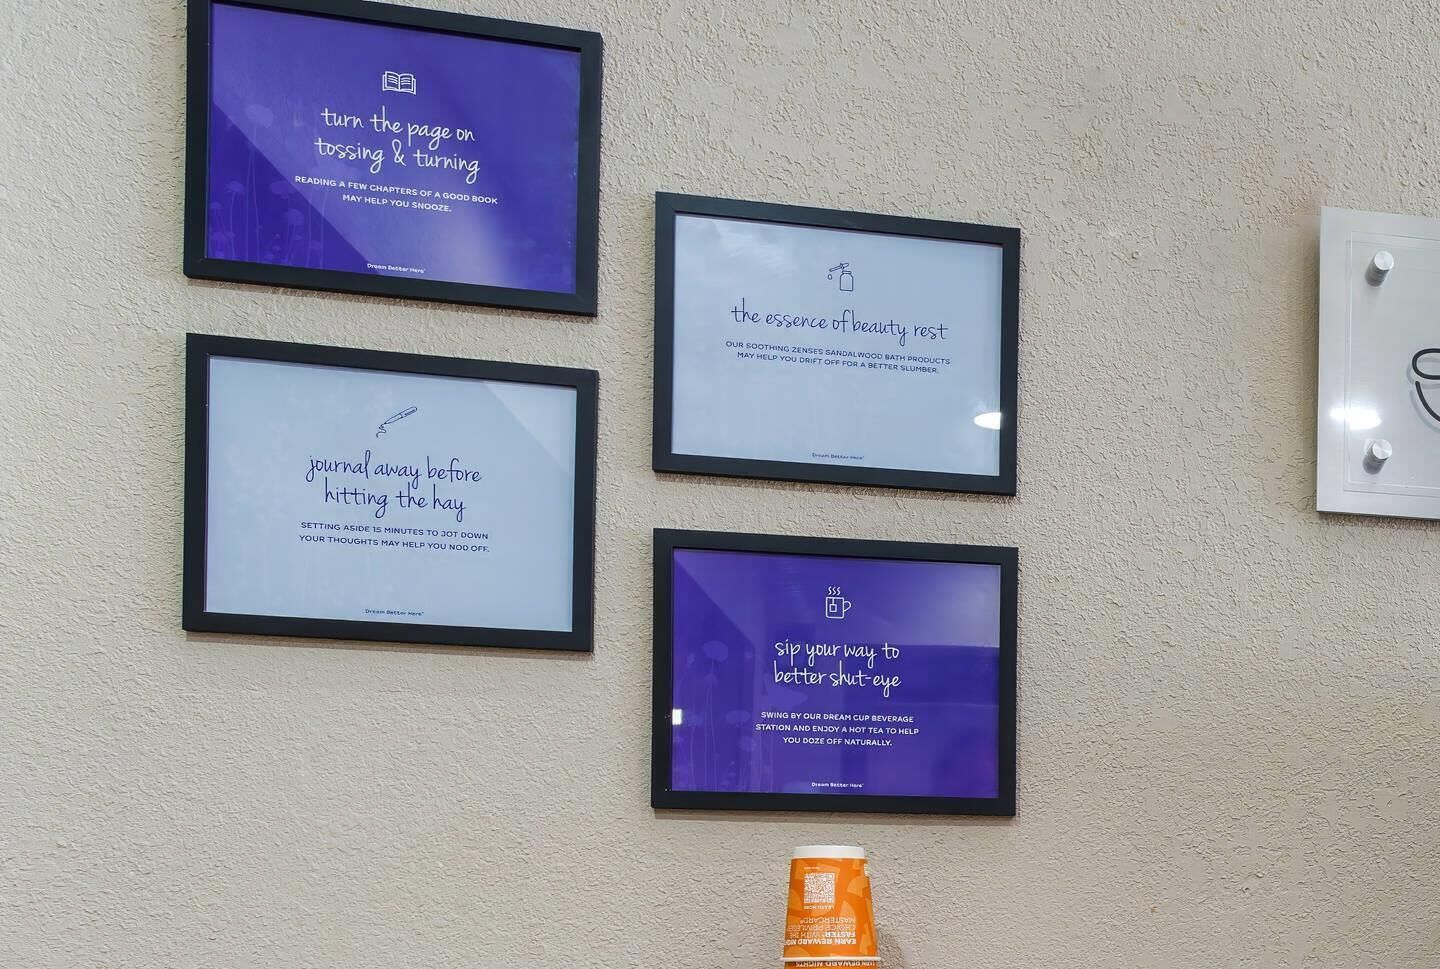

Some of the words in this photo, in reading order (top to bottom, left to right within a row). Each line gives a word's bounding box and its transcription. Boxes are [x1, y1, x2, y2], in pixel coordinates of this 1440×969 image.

[321, 108, 364, 128] turn
[370, 105, 403, 133] the
[408, 122, 452, 150] page
[456, 129, 475, 141] on
[315, 138, 384, 173] tossing
[392, 139, 406, 166] &
[413, 150, 480, 184] turning
[295, 176, 337, 187] READING
[348, 182, 367, 190] FEW
[370, 184, 417, 196] CHAPTERS
[443, 192, 469, 201] GOOD
[472, 195, 498, 204] BOOK
[343, 194, 362, 202] MAY
[364, 197, 387, 205] HELP
[390, 200, 409, 208] YOU
[412, 202, 451, 212] SNOOZE.
[731, 298, 760, 323] the
[766, 313, 828, 329] essence
[832, 310, 850, 333] of
[852, 310, 908, 346] beauty
[914, 323, 948, 339] rest
[746, 342, 789, 352] SOOTHING
[792, 346, 823, 355] ZENSES
[826, 349, 882, 359] SANDALWOOD
[908, 356, 950, 364] PRODUCTS
[757, 353, 777, 361] HELP
[800, 356, 822, 364] DRIFT
[868, 362, 898, 370] BETTER
[900, 365, 939, 373] SLUMBER.
[306, 450, 371, 482] journal
[374, 463, 422, 489] away
[427, 456, 482, 483] before
[325, 477, 388, 518] hitting
[396, 482, 428, 508] the
[433, 484, 466, 522] hay
[300, 535, 325, 543] YOUR
[328, 537, 378, 545] THOUGHTS
[301, 522, 340, 531] SETTING
[384, 527, 423, 535] MINUTES
[775, 639, 800, 666] sip
[806, 643, 840, 666] your
[844, 646, 877, 669] way
[882, 643, 899, 659] to
[774, 660, 826, 684] better
[830, 660, 901, 697] shut-eye
